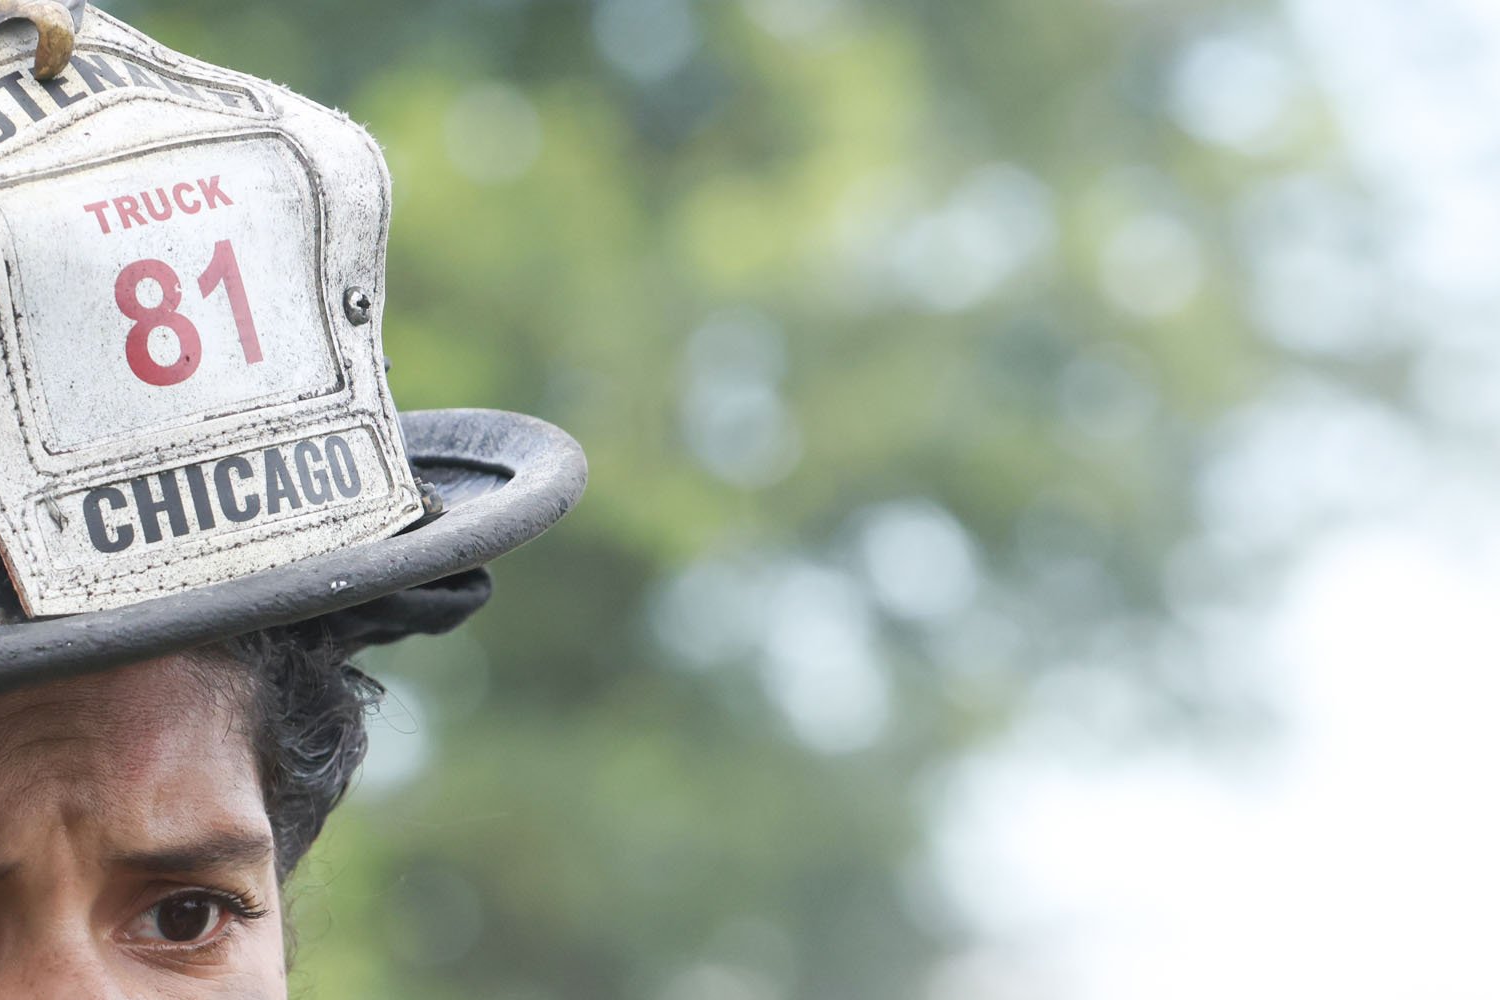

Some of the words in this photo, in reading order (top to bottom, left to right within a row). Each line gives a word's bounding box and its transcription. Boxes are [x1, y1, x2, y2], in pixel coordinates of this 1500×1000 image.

[84, 175, 234, 235] TRUCK
[114, 239, 264, 386] 81
[82, 435, 363, 553] CHICAGO
